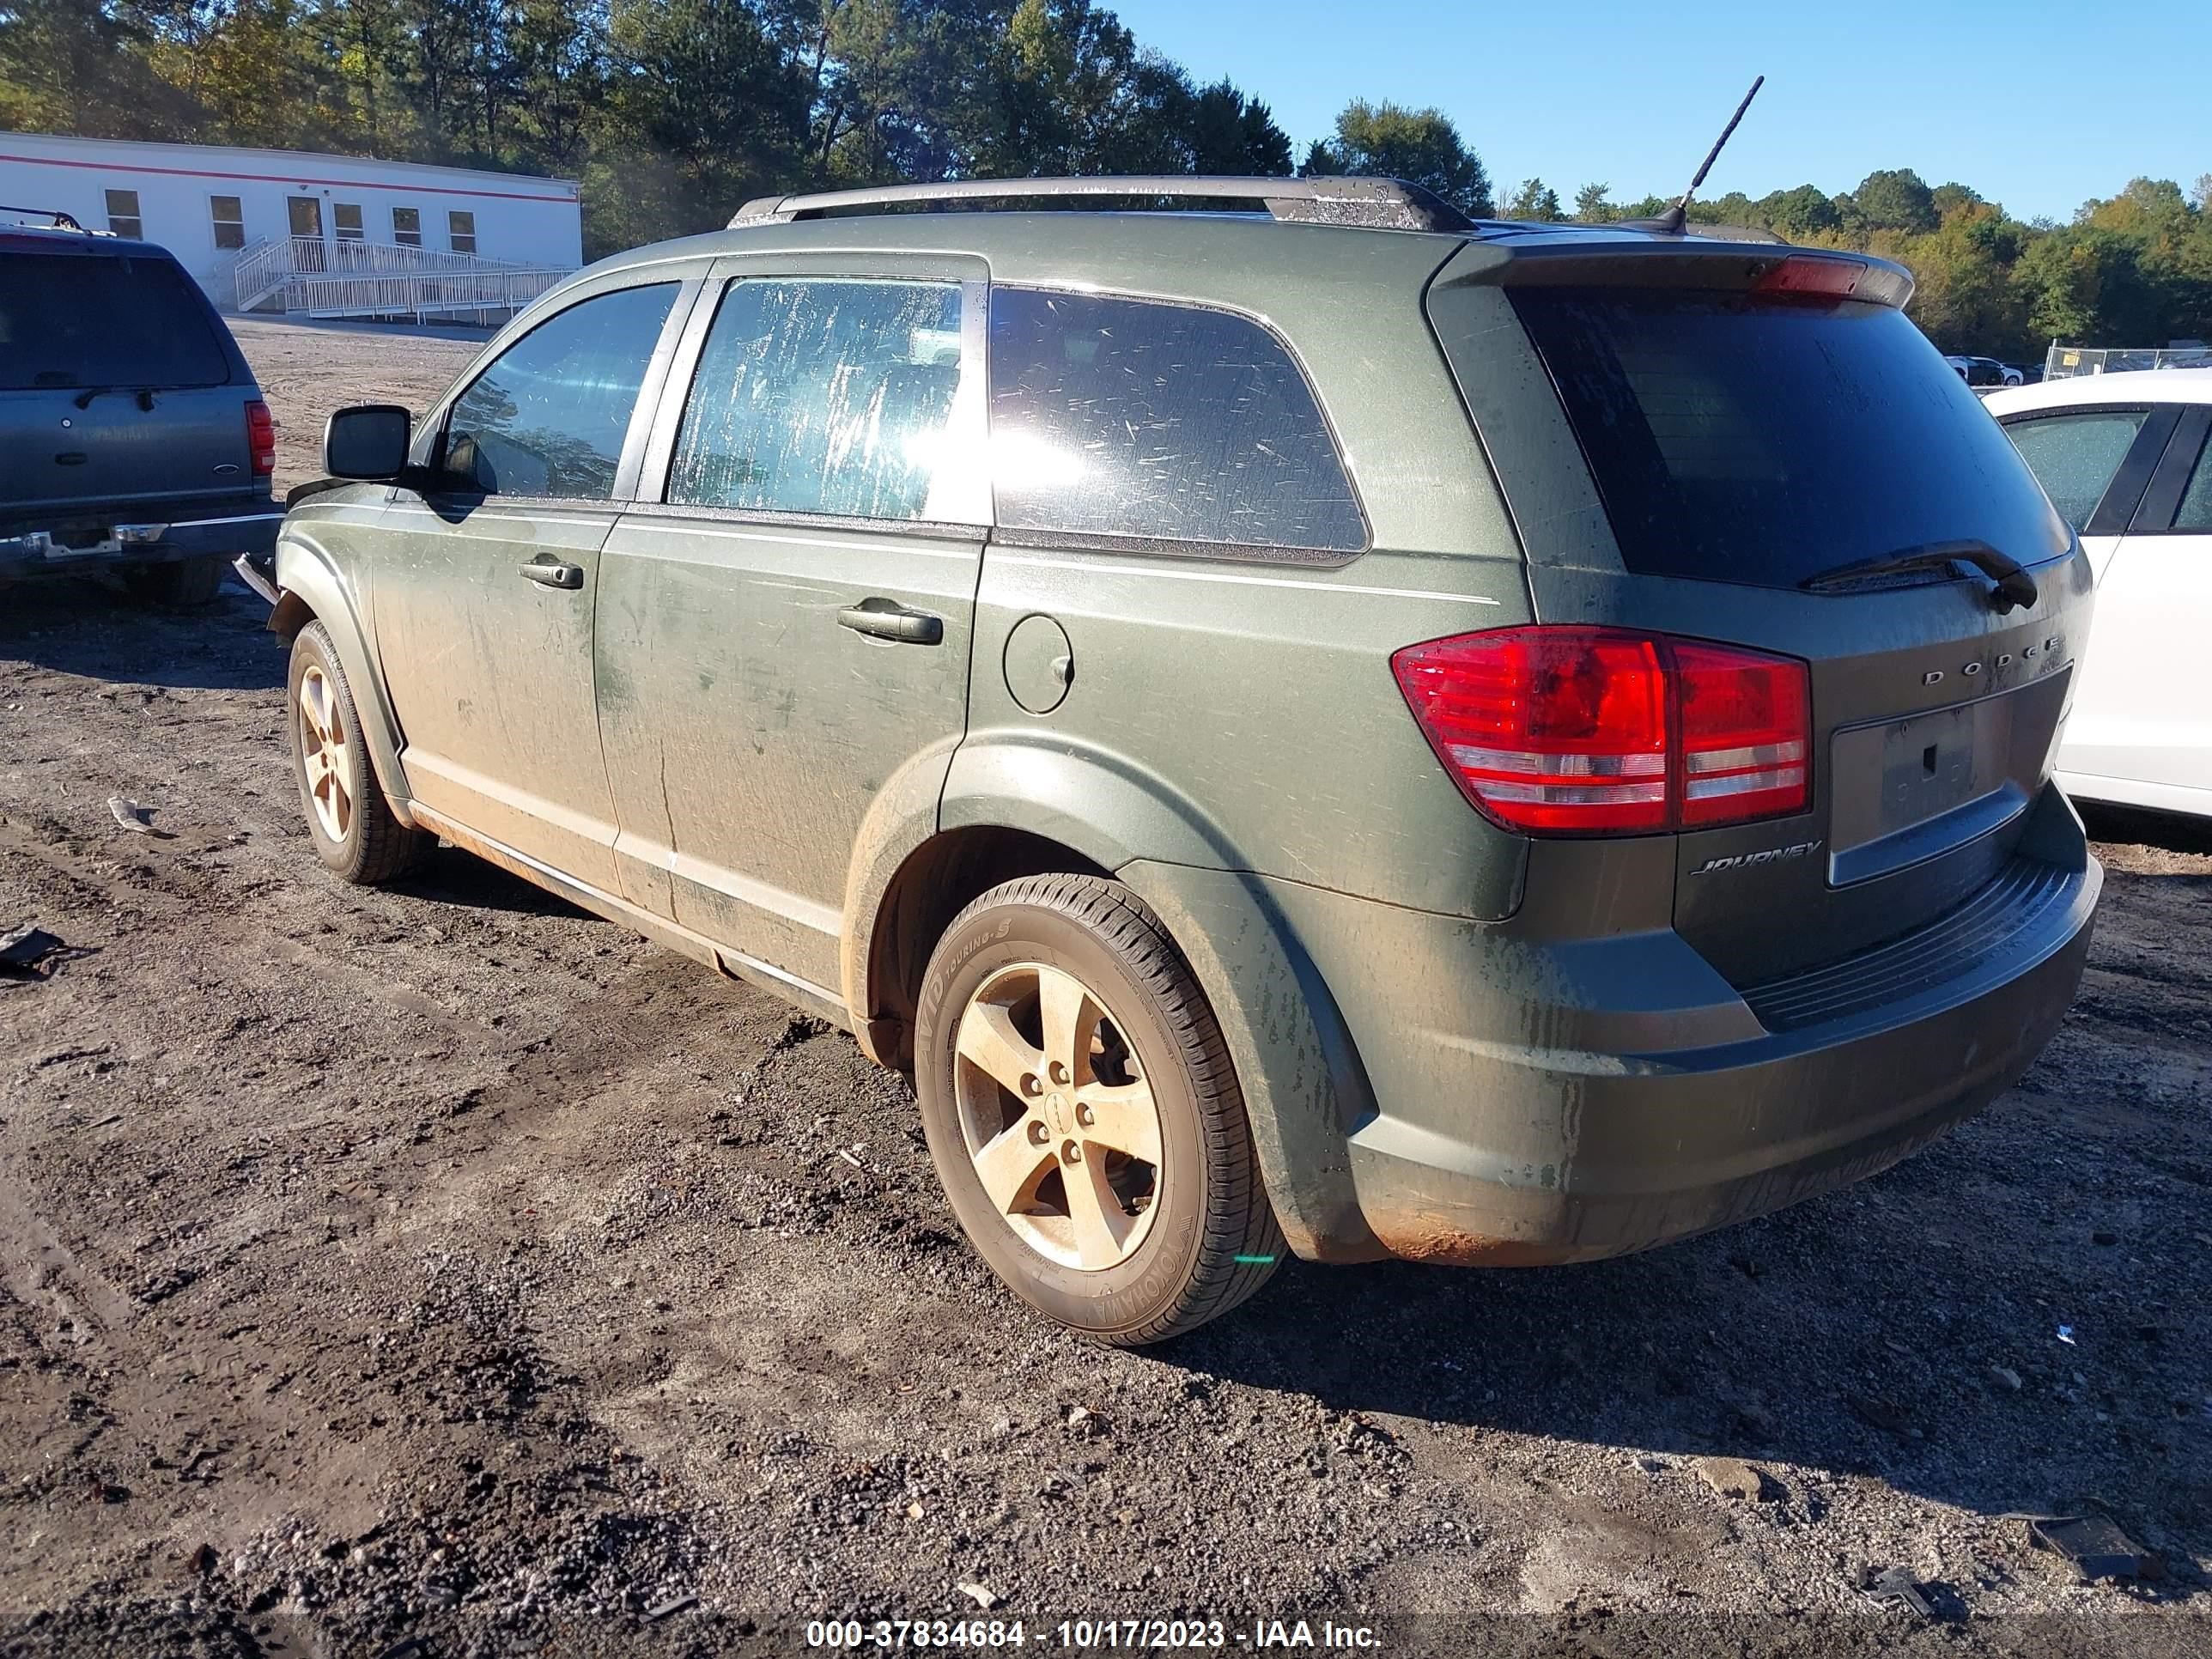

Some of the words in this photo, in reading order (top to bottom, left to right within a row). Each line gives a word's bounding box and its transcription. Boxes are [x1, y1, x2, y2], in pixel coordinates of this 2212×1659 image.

[1923, 637, 2059, 686] DODGE
[1689, 839, 1823, 876] JOURNEY
[1092, 1245, 1185, 1323] YOKOHAMA
